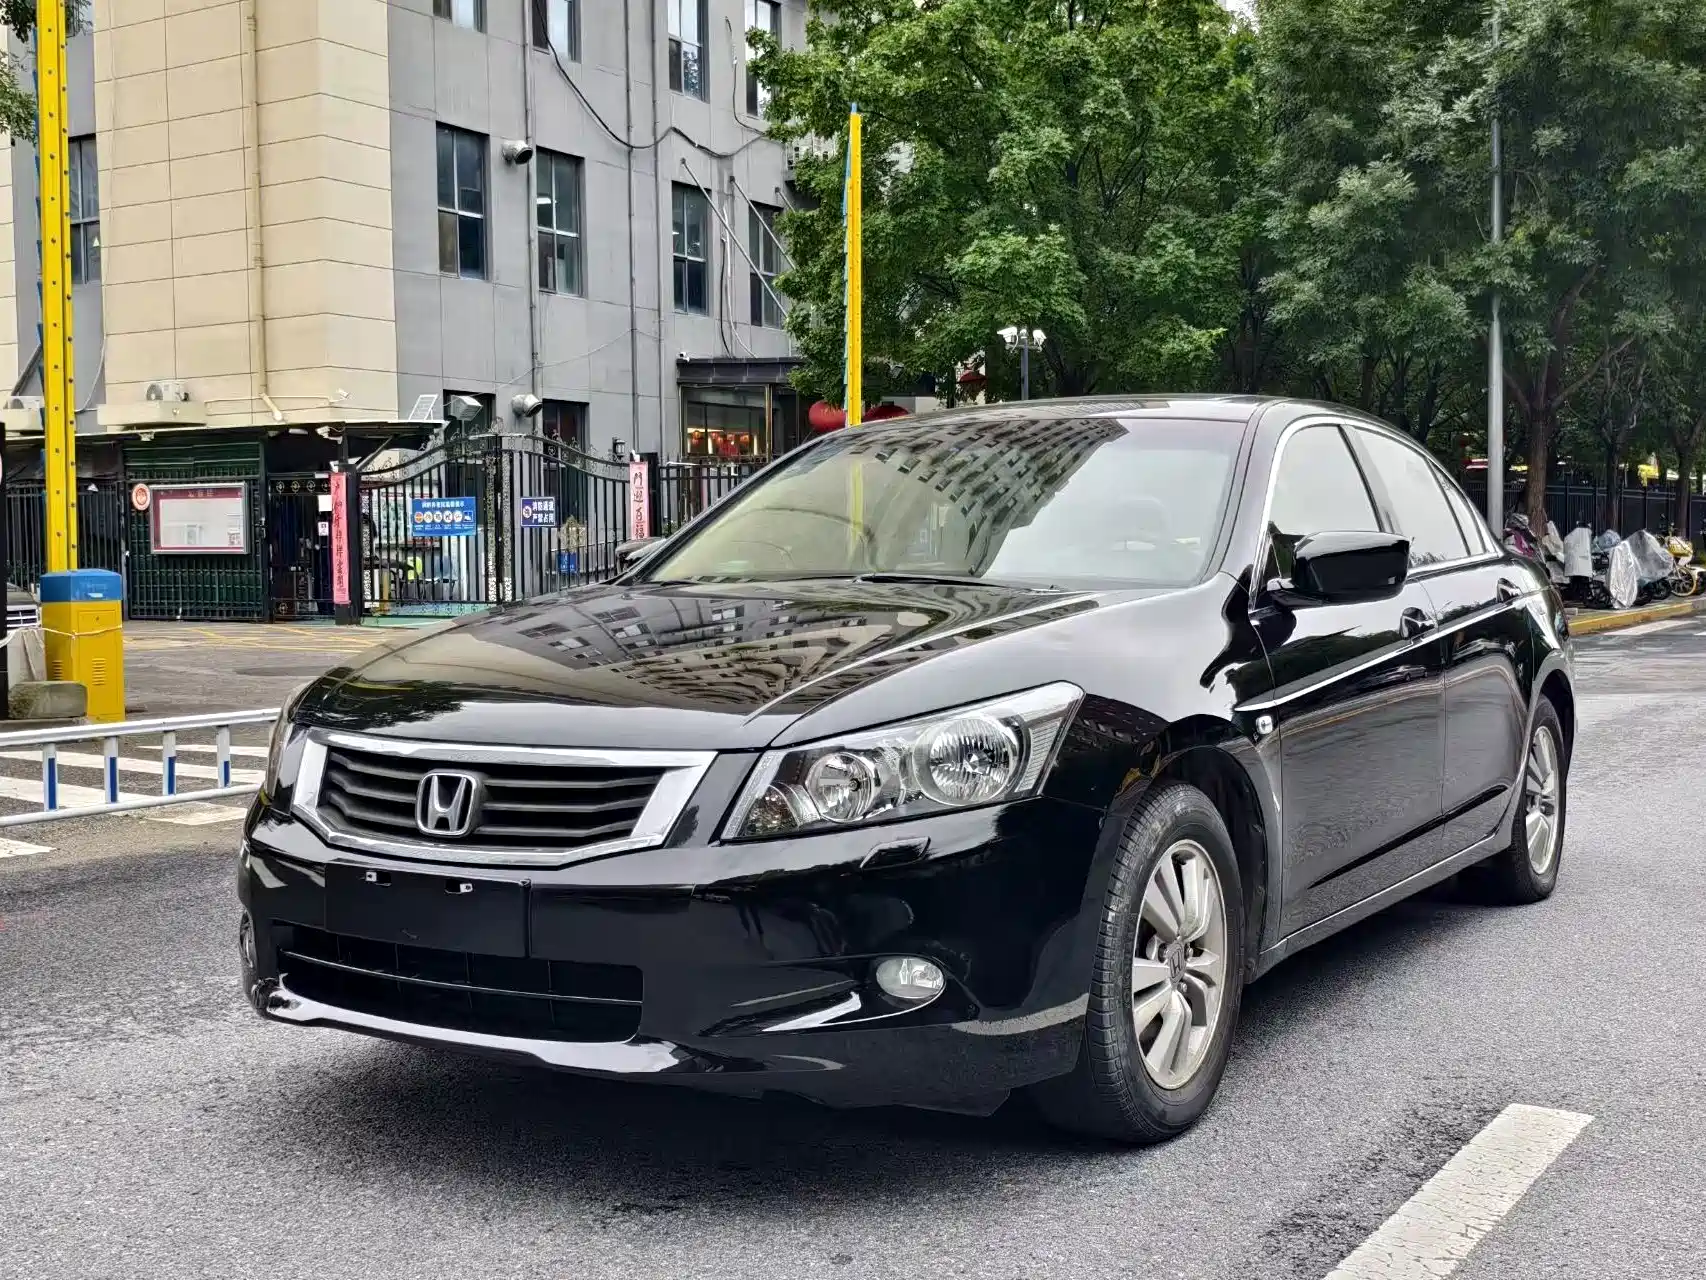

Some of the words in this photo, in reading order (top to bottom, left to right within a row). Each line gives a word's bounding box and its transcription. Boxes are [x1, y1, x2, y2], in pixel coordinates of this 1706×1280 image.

[532, 500, 554, 511] 消防通道
[532, 512, 554, 524] 严禁占用
